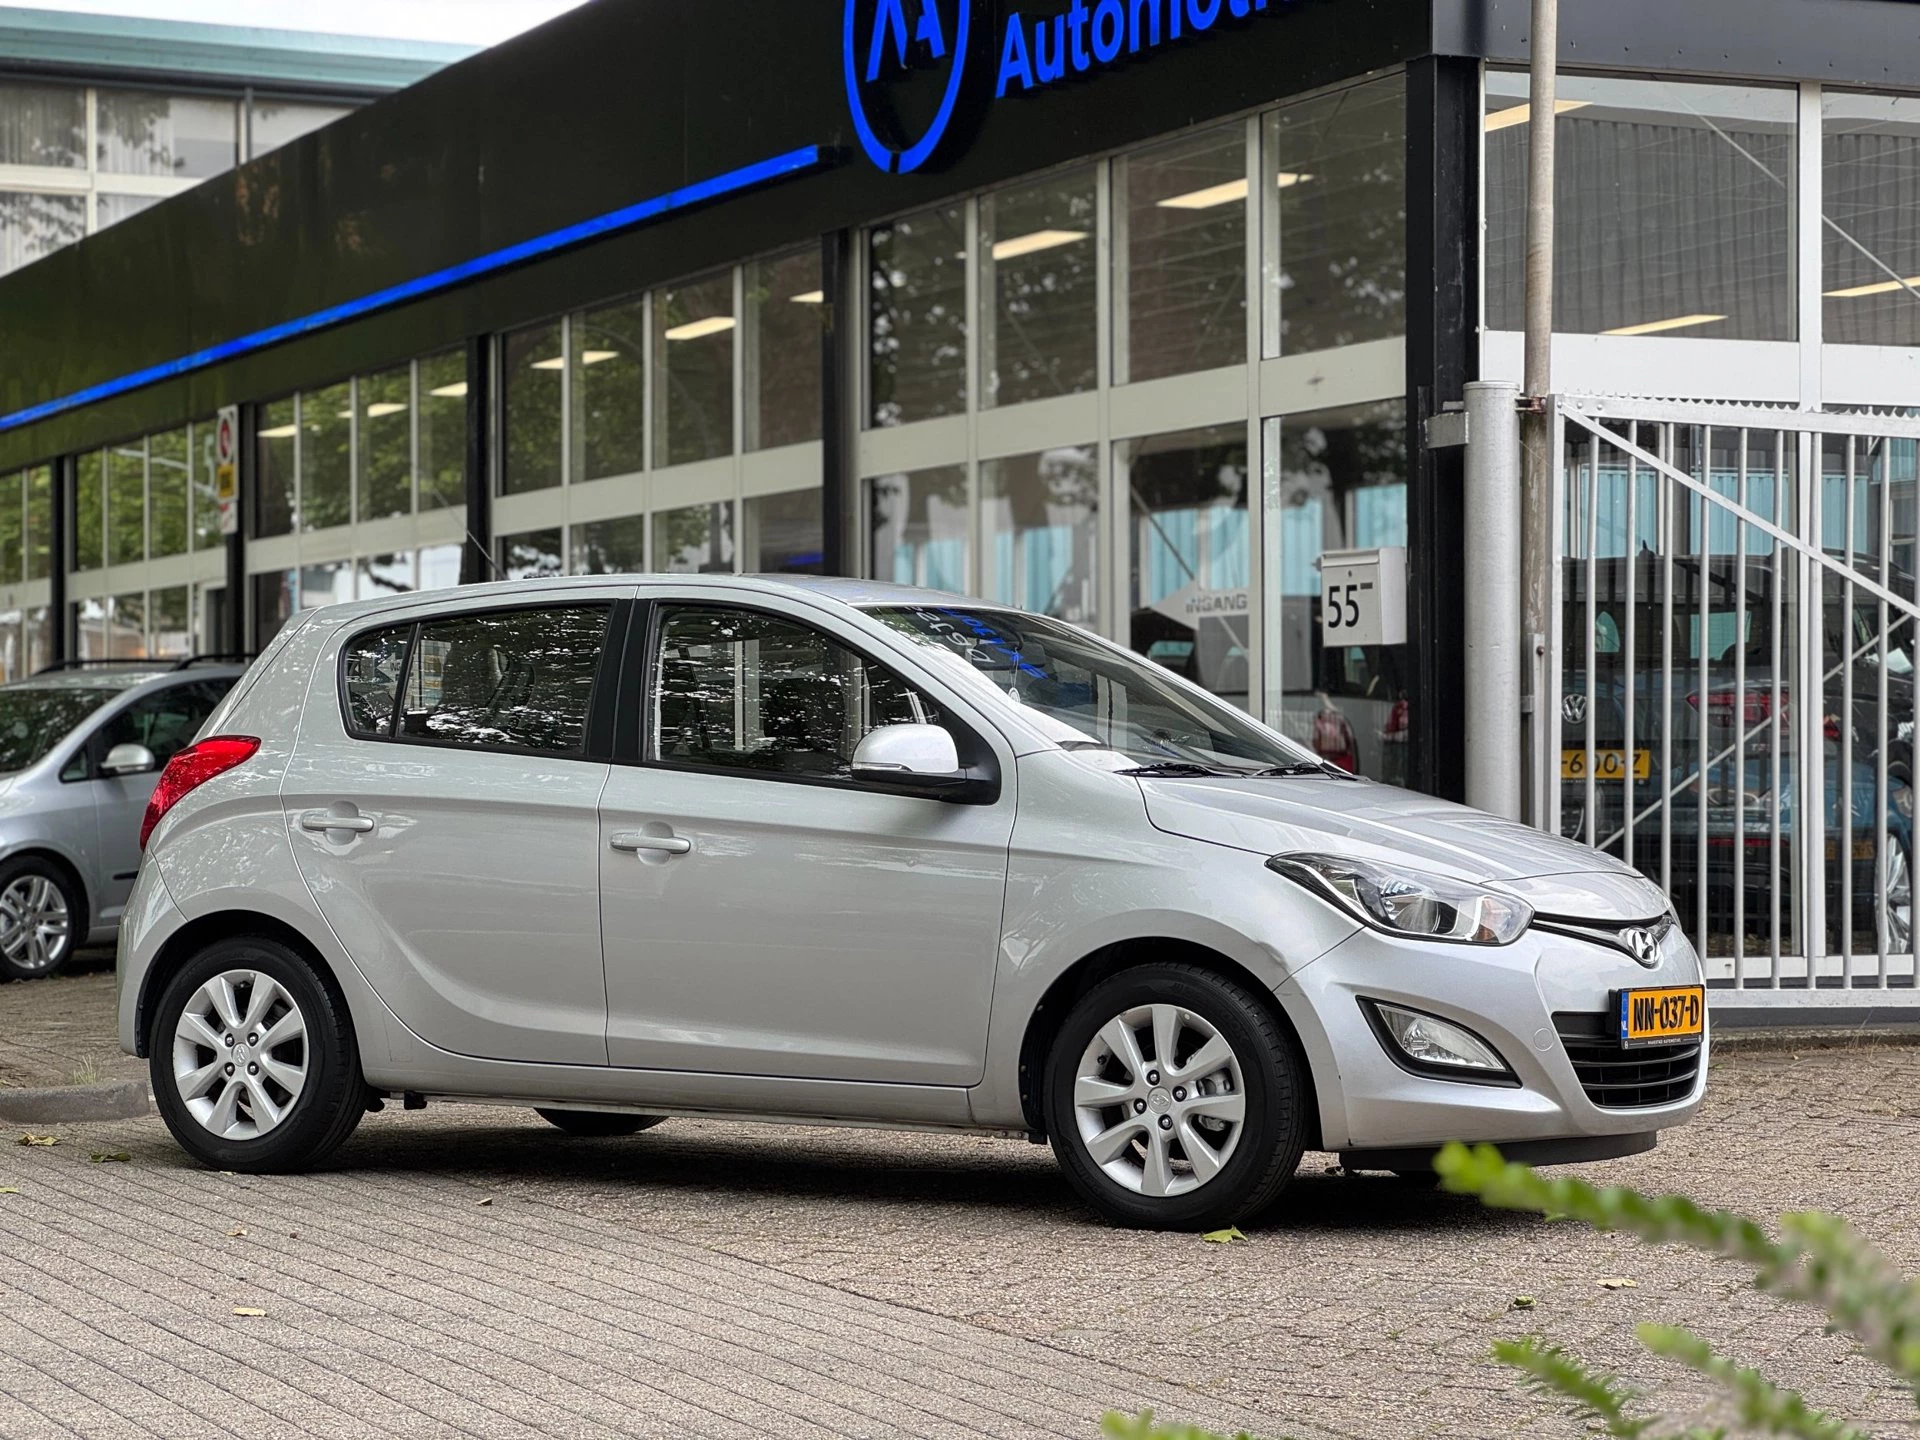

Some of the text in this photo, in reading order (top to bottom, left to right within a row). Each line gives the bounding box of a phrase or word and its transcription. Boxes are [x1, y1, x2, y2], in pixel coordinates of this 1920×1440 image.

[996, 0, 1267, 99] Automo
[1328, 584, 1359, 628] 55
[1633, 994, 1700, 1032] NN-037-D
